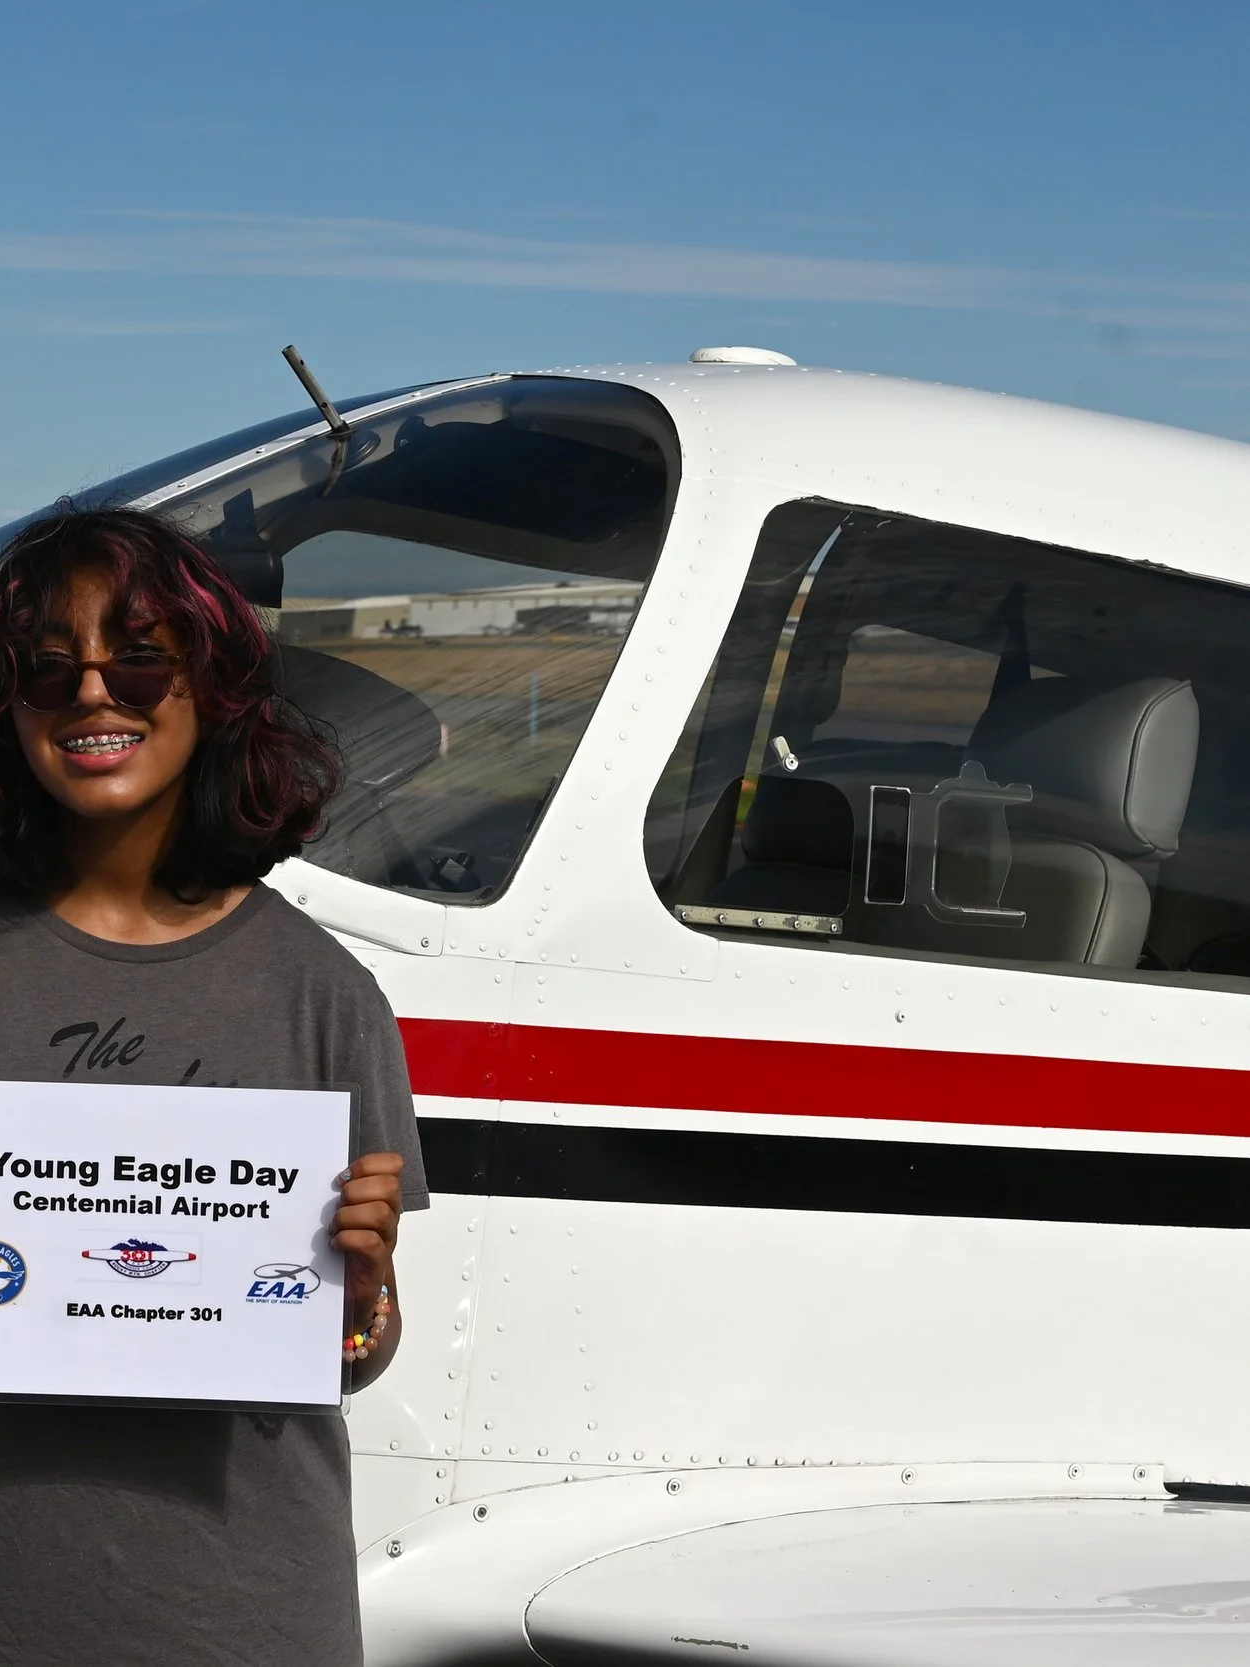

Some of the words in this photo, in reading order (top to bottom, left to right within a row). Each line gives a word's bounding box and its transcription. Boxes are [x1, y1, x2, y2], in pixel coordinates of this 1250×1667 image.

[49, 1017, 146, 1079] The
[113, 1155, 217, 1190] Eagle
[229, 1159, 300, 1194] Day
[12, 1190, 162, 1215] Centennial
[170, 1196, 270, 1222] Airport
[246, 1281, 306, 1299] EAA
[66, 1303, 105, 1318] EAA
[110, 1304, 185, 1323] Chapter
[189, 1307, 222, 1322] 301
